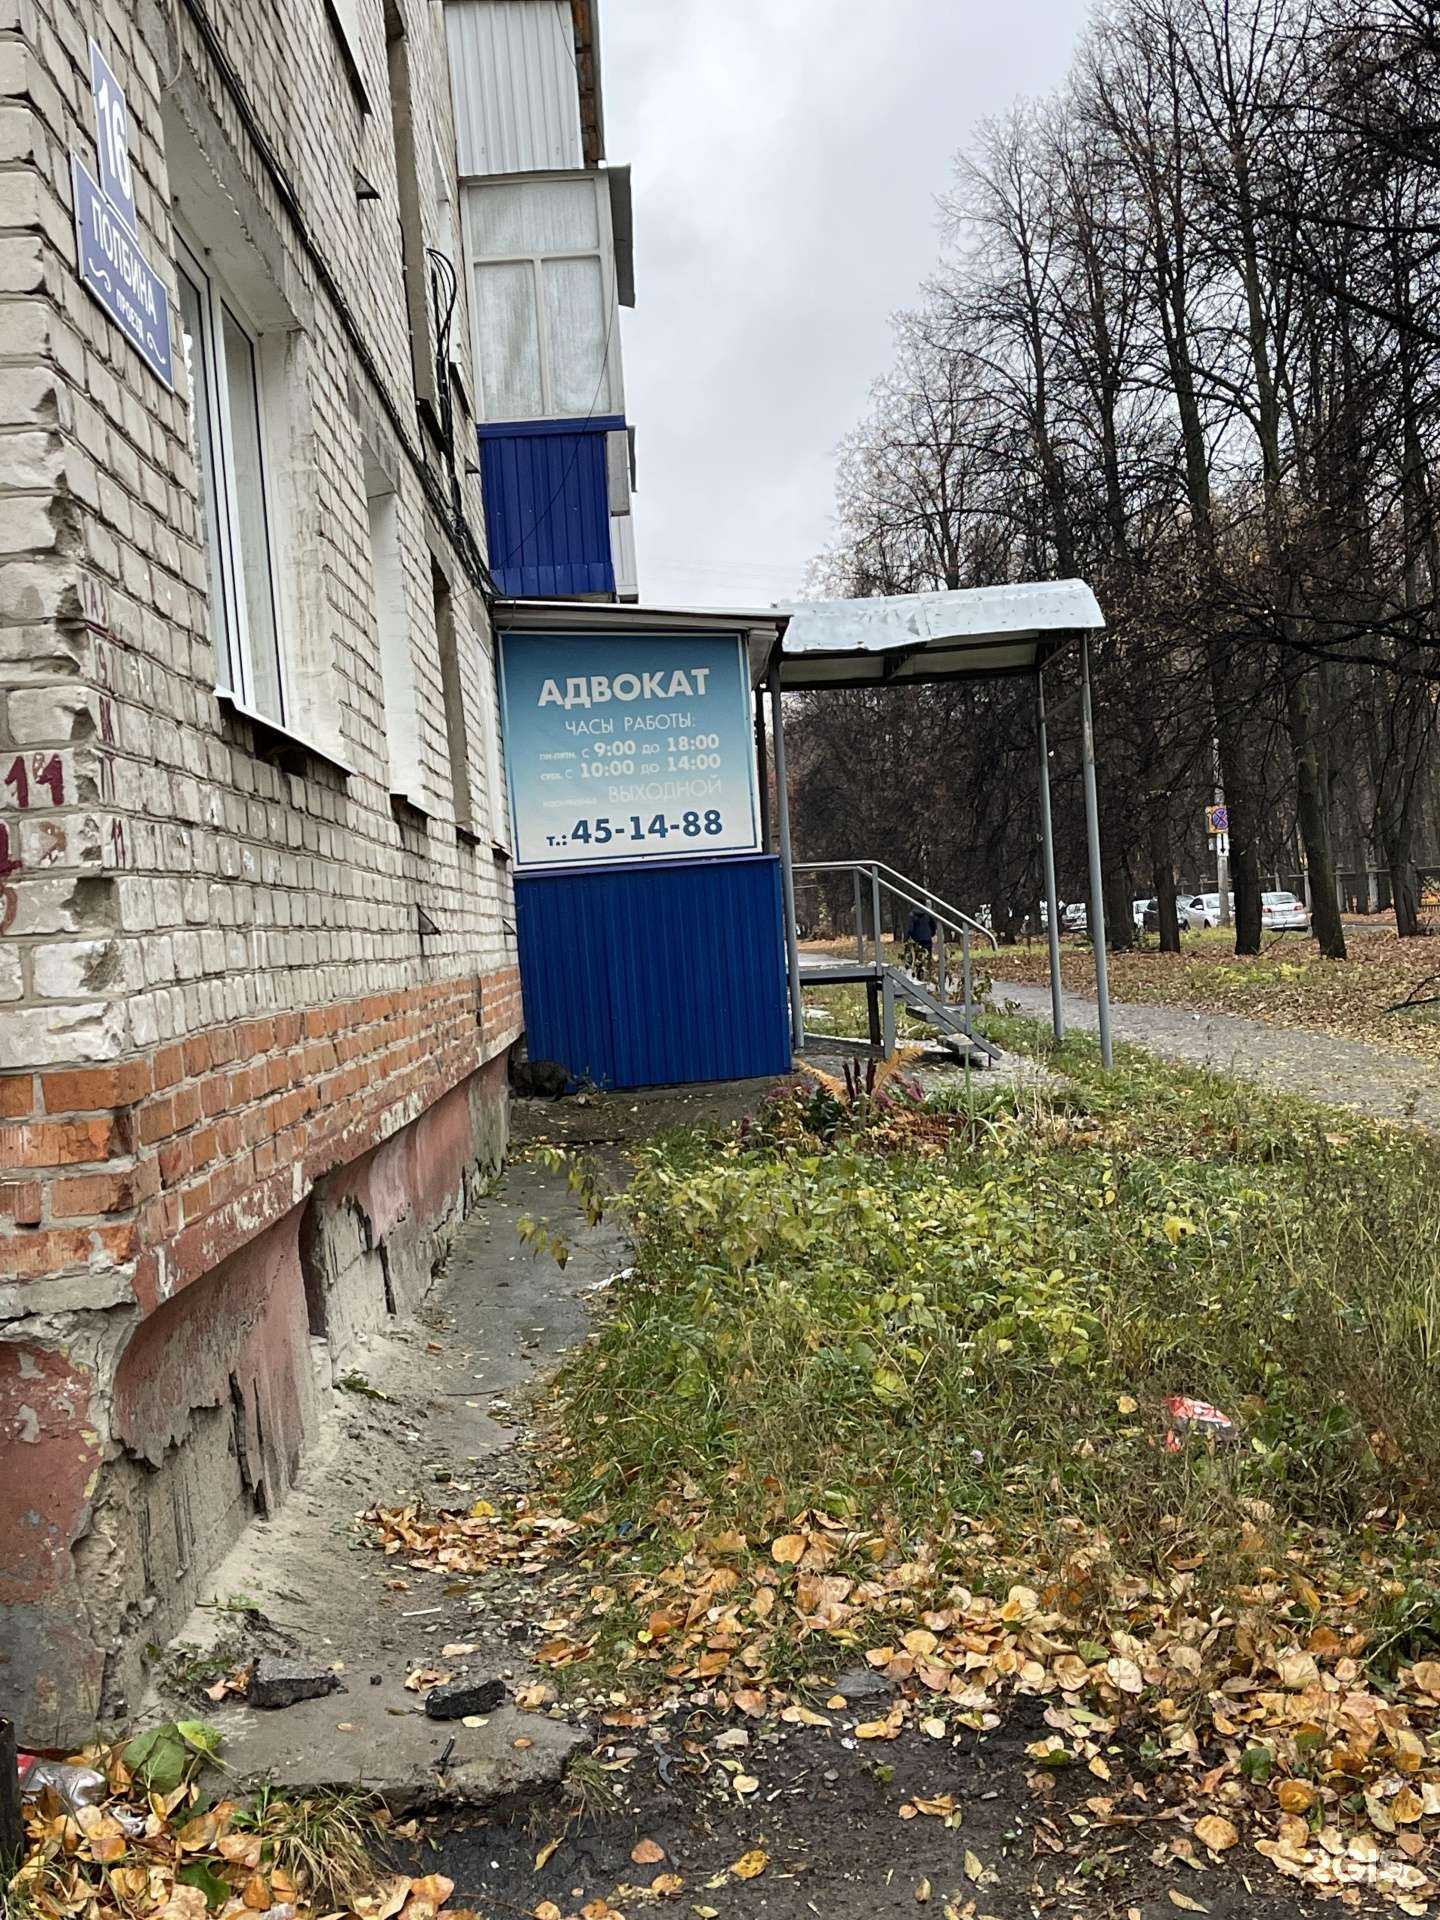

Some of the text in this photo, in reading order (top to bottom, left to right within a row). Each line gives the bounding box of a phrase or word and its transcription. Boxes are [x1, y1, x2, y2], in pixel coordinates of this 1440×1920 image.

[99, 79, 130, 200] 16
[91, 195, 157, 325] ПОЛБИНА
[116, 289, 144, 342] ПРОЕЗД
[537, 668, 710, 710] АДВОКАТ
[565, 712, 696, 736] ЧАСЫ РАБОТЫ:
[594, 740, 636, 757] 9:00
[641, 743, 660, 755] до
[667, 733, 720, 752] 18:00
[580, 760, 635, 779] 10:00
[640, 763, 660, 776] до
[667, 754, 721, 773] 14:00
[607, 774, 722, 803] ВЫХОДНОЙ
[571, 809, 723, 844] 45-14-88
